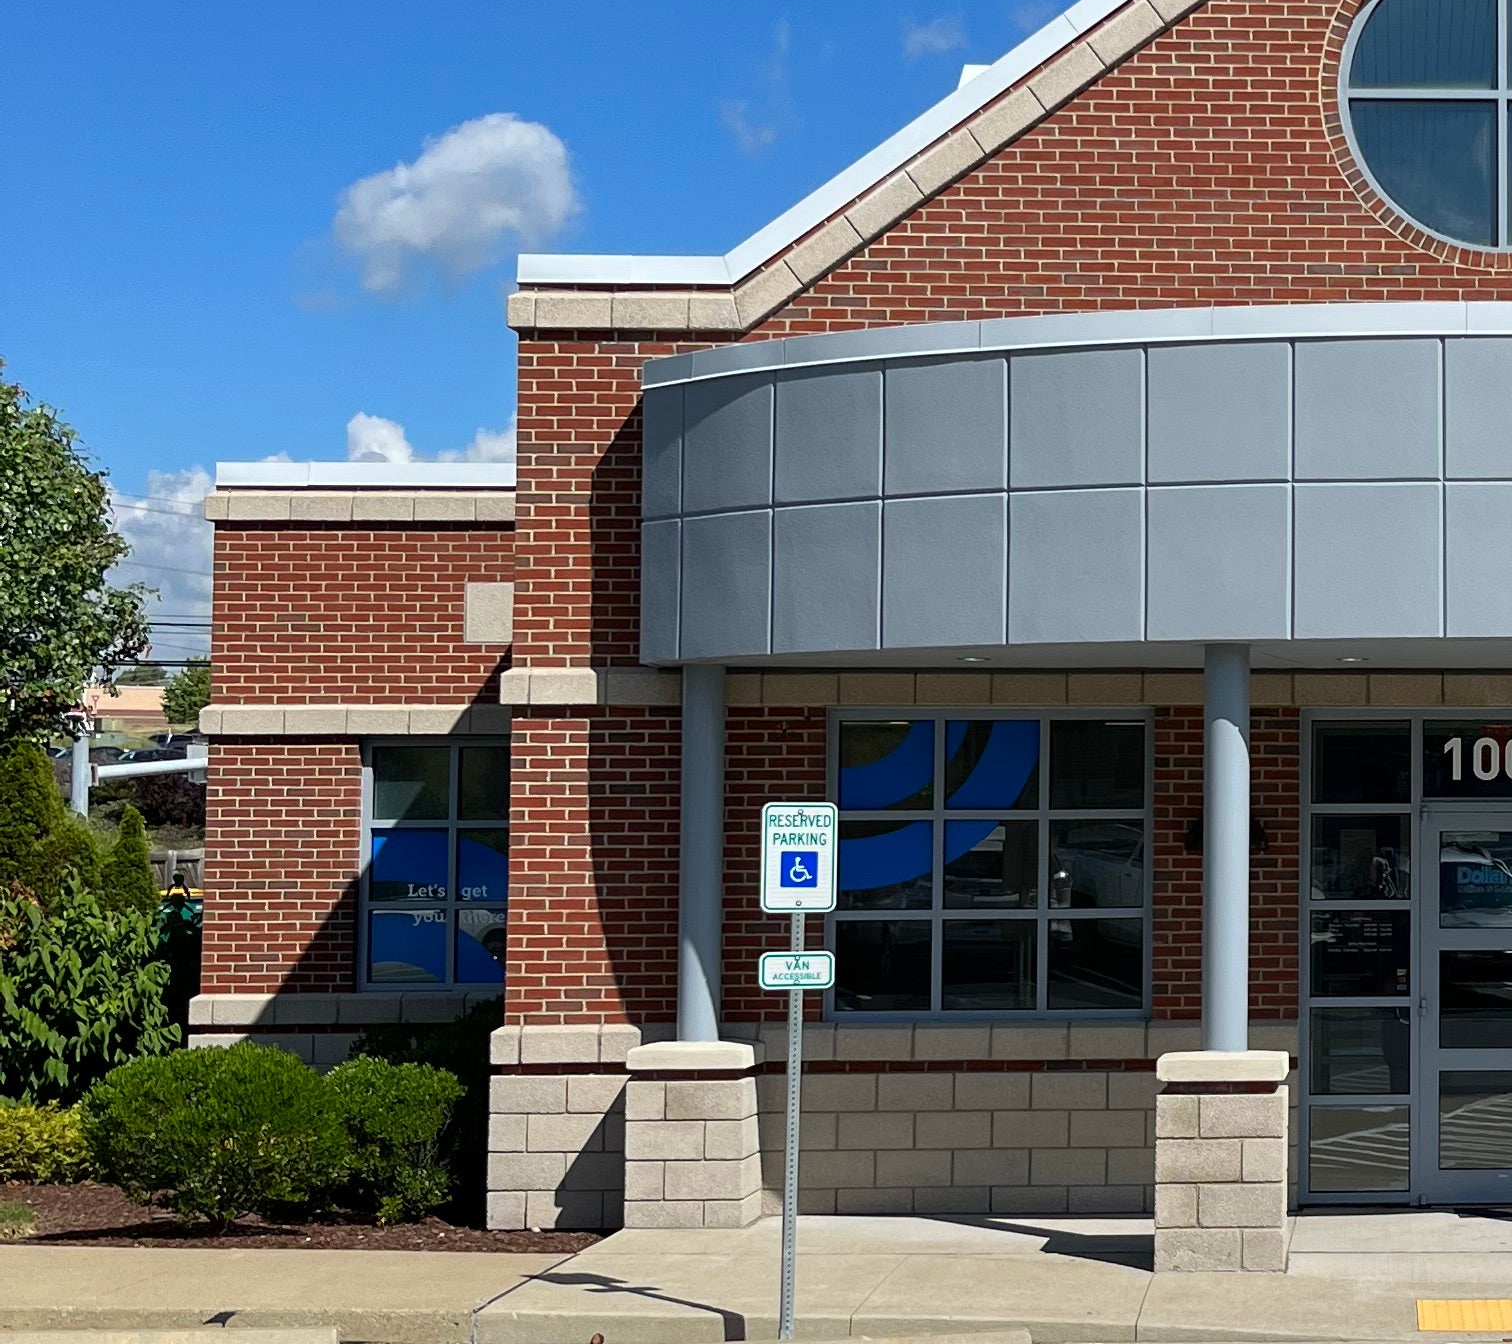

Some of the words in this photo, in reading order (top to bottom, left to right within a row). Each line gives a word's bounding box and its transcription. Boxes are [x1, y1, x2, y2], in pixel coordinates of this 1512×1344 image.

[769, 814, 831, 828] RESERVED
[772, 832, 827, 846] PARKING
[407, 883, 446, 897] Let's
[461, 884, 488, 901] get
[412, 911, 447, 926] you
[785, 960, 810, 971] VAN
[772, 972, 822, 981] ACCESSIBLE
